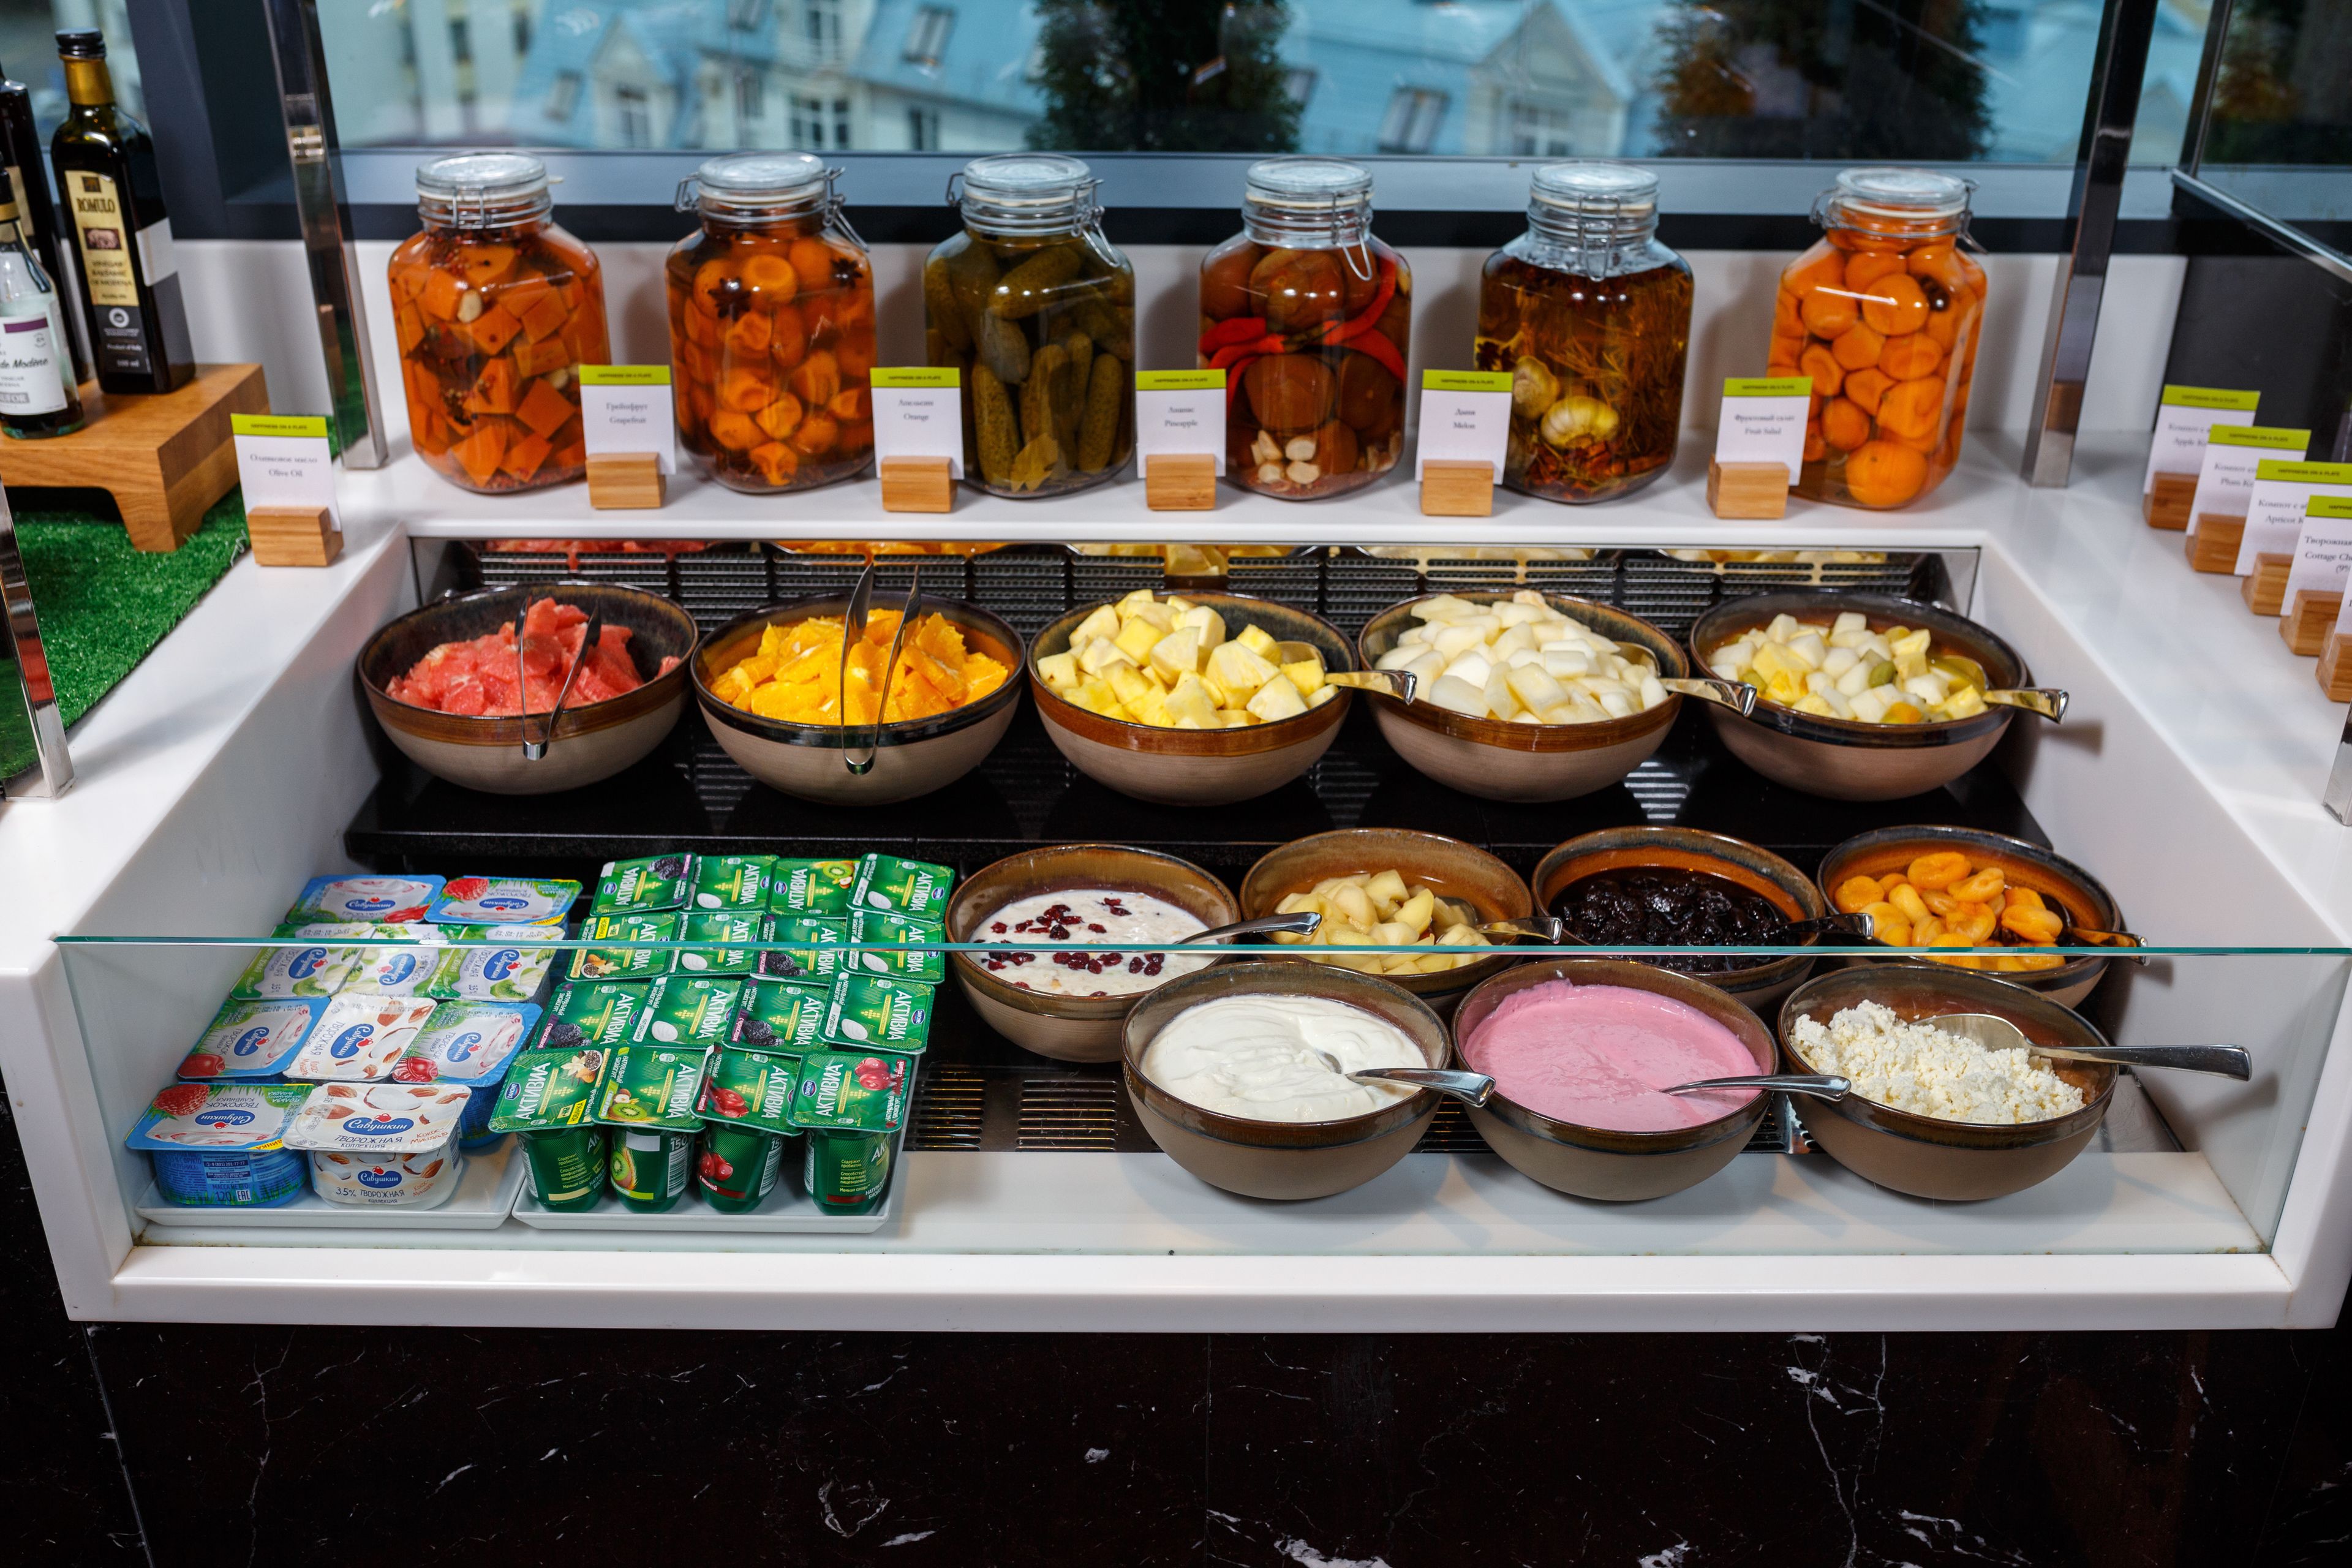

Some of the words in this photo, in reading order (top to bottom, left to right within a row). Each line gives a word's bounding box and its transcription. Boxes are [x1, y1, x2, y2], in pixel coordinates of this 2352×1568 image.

[77, 198, 115, 213] ROMULO
[903, 413, 929, 421] Orange
[1164, 420, 1198, 428] Pineapple
[2173, 437, 2195, 447] Apple
[268, 468, 289, 477] Olive
[290, 469, 303, 478] Oil
[2220, 478, 2241, 486] Plum
[2258, 499, 2291, 509] Компот
[2264, 514, 2296, 524] Apricot
[2305, 551, 2338, 562] Cottage
[615, 867, 640, 905] АКТИВИА
[739, 864, 760, 905] АКТИВИА
[788, 869, 808, 910] АКТИВИА
[908, 870, 933, 911] АКТИВИА
[483, 899, 526, 909] Савушкин
[630, 923, 658, 971] АКТВИА
[600, 993, 635, 1045] АКТИВИА
[696, 989, 729, 1039] АКТИВИА
[793, 996, 822, 1046] АКТИВИА
[887, 989, 913, 1041] АКТИВИА
[240, 1028, 267, 1055] Савушкин
[310, 1020, 345, 1056] ТВОРОЖНАЯ
[337, 1025, 371, 1057] Савушкин
[452, 1033, 479, 1060] Савушкин
[611, 1057, 622, 1079] БИОЙОГУРТ
[616, 1056, 629, 1084] НАТУРАЛЬНЫЙ
[507, 1084, 518, 1099] DANONE
[515, 1062, 551, 1120] АКТИВИА
[665, 1063, 696, 1118] АКТИВИА
[761, 1065, 790, 1119] АКТИВИА
[804, 1082, 813, 1096] DANONE
[815, 1064, 843, 1117] АКТИВИА
[201, 1112, 251, 1123] Савушкин
[884, 1094, 895, 1121] НАТУРАЛЬНЫЙ
[892, 1098, 901, 1119] БИОЙОГУРТ
[347, 1119, 408, 1132] Савушкин
[334, 1135, 403, 1144] ТВОРОЖНАЯ
[360, 1172, 399, 1184] Савушкин
[701, 1177, 718, 1192] вишней
[216, 1191, 232, 1202] 120
